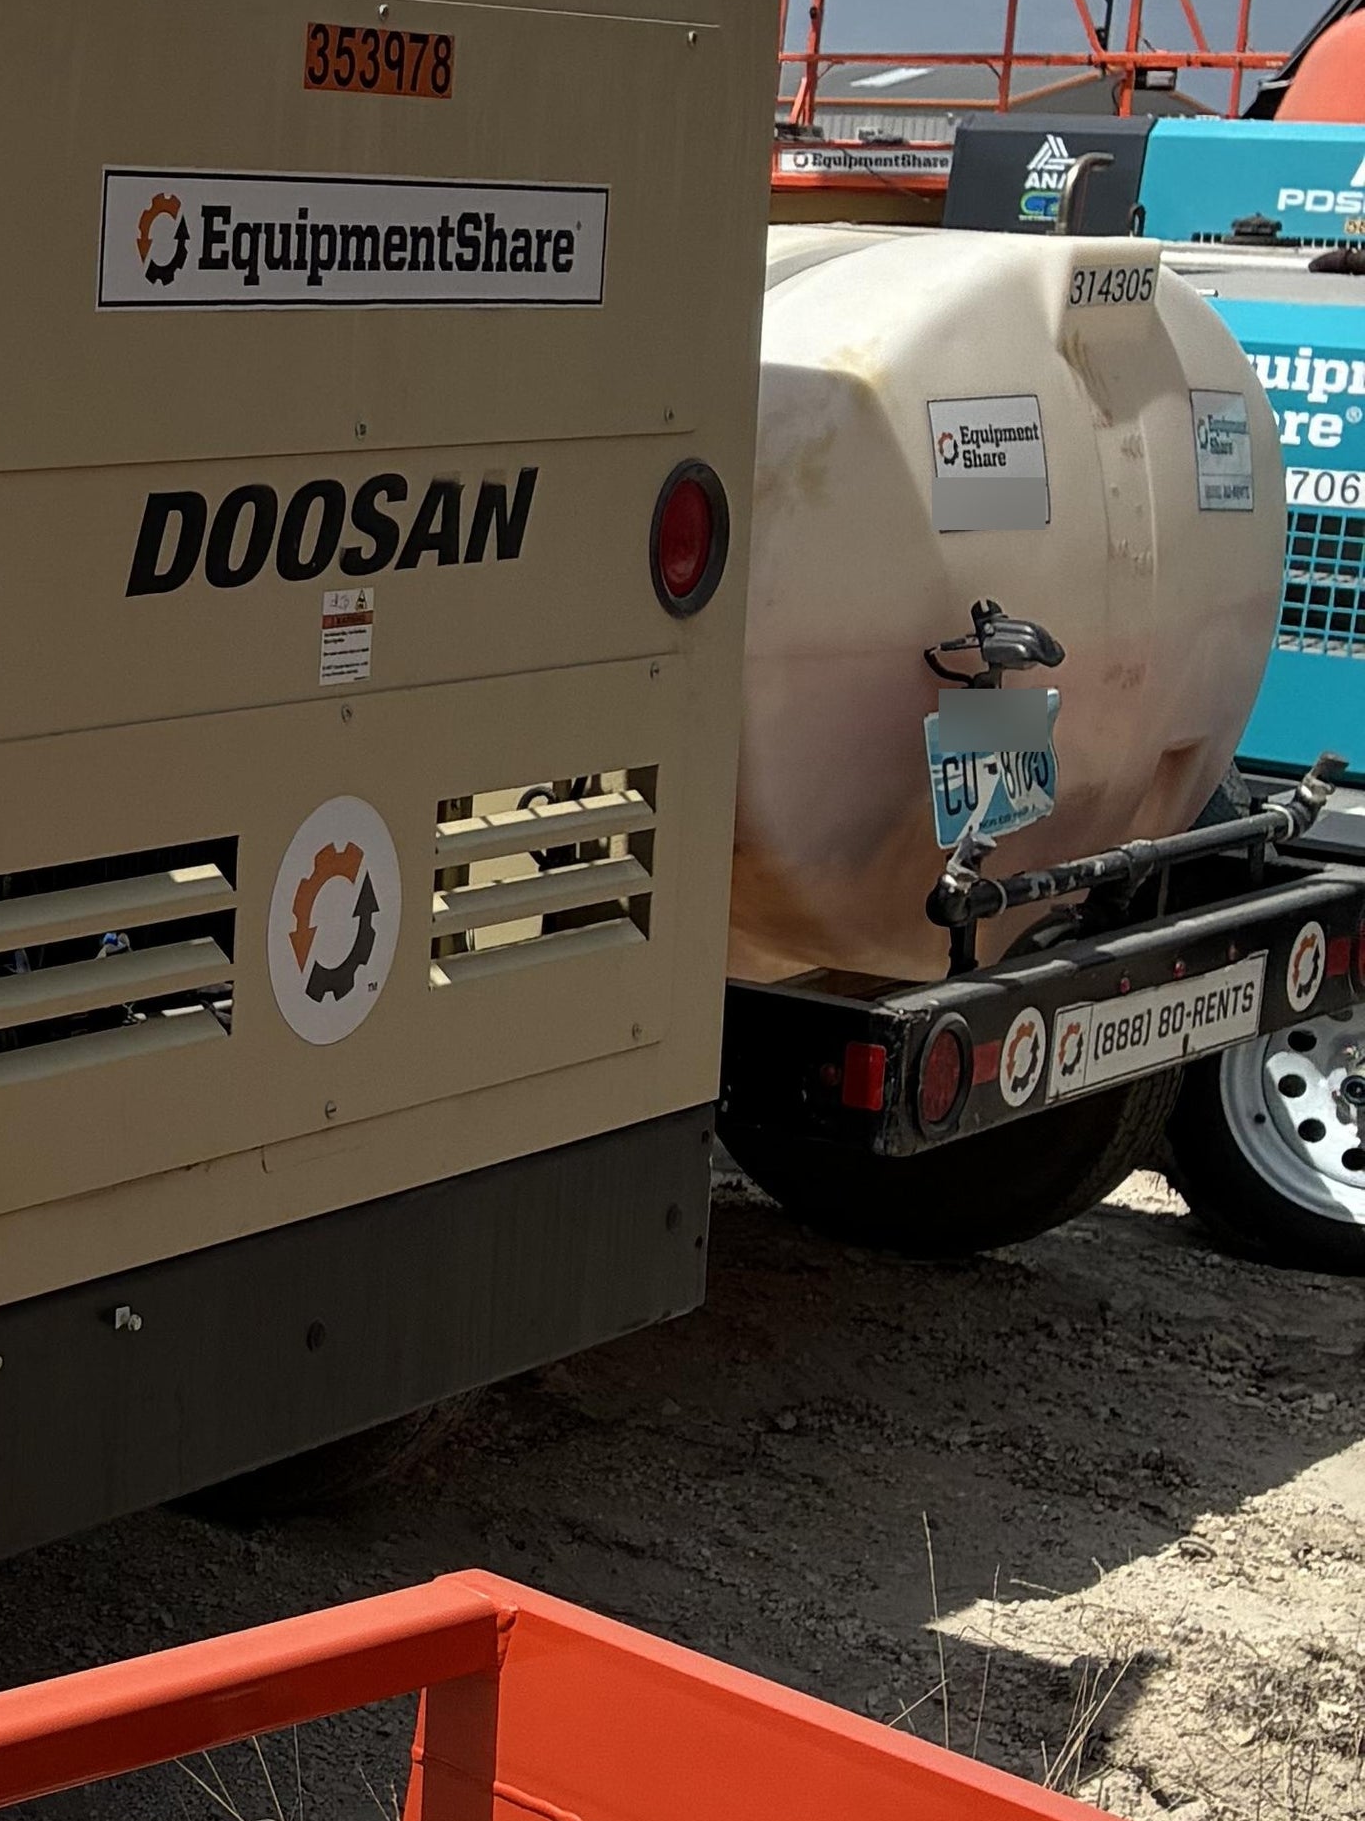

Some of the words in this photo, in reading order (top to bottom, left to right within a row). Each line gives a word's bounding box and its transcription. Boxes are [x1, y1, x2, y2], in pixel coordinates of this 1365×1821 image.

[307, 23, 452, 95] 353978
[811, 152, 950, 170] EquipmentShare
[196, 204, 576, 287] EquipmentShare
[1070, 267, 1154, 305] 314305
[959, 422, 1040, 450] Equipment
[962, 449, 1007, 470] Share
[124, 465, 540, 598] DOOSAN
[1093, 1007, 1153, 1061] (888)
[1157, 980, 1256, 1039] 80-RENTS
